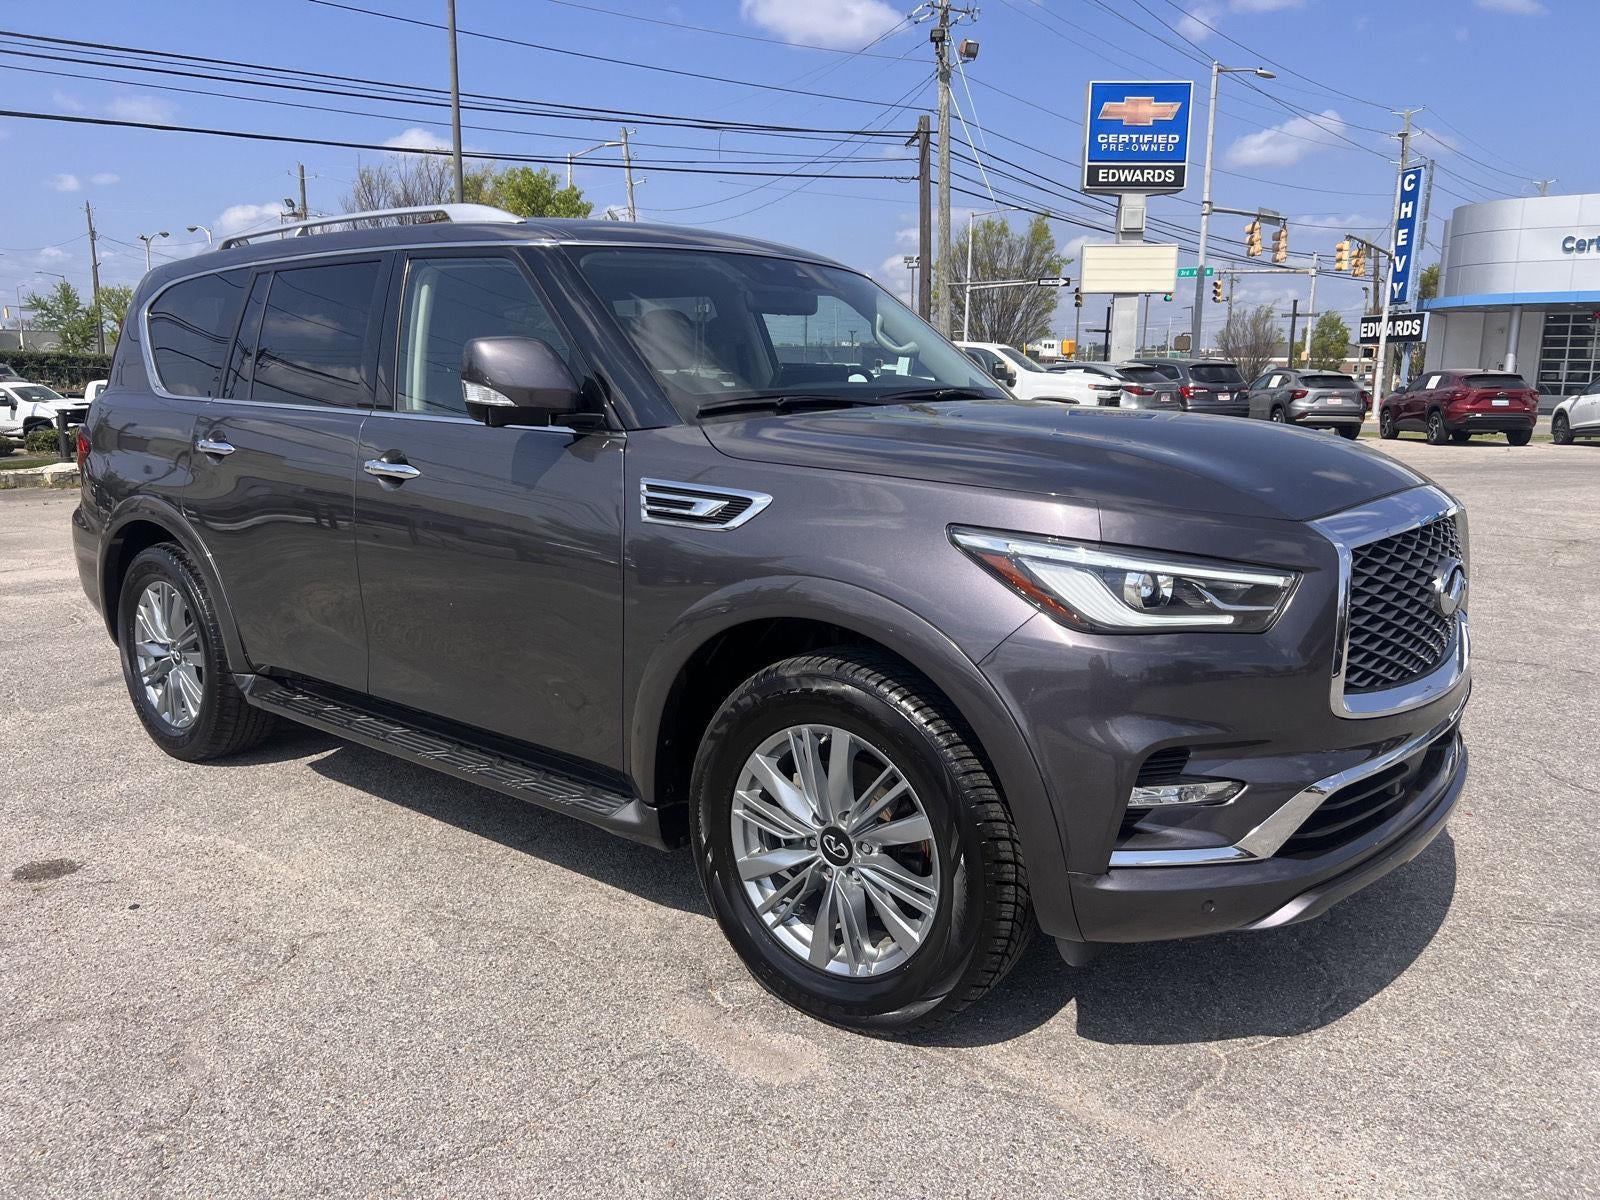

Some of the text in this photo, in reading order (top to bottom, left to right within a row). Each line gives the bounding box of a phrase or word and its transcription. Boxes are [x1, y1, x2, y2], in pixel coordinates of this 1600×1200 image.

[1097, 134, 1180, 143] CERTIFIED
[1101, 144, 1175, 152] PRE-OWNED
[1098, 169, 1175, 182] EDWARDS
[1392, 174, 1416, 299] CHEVY
